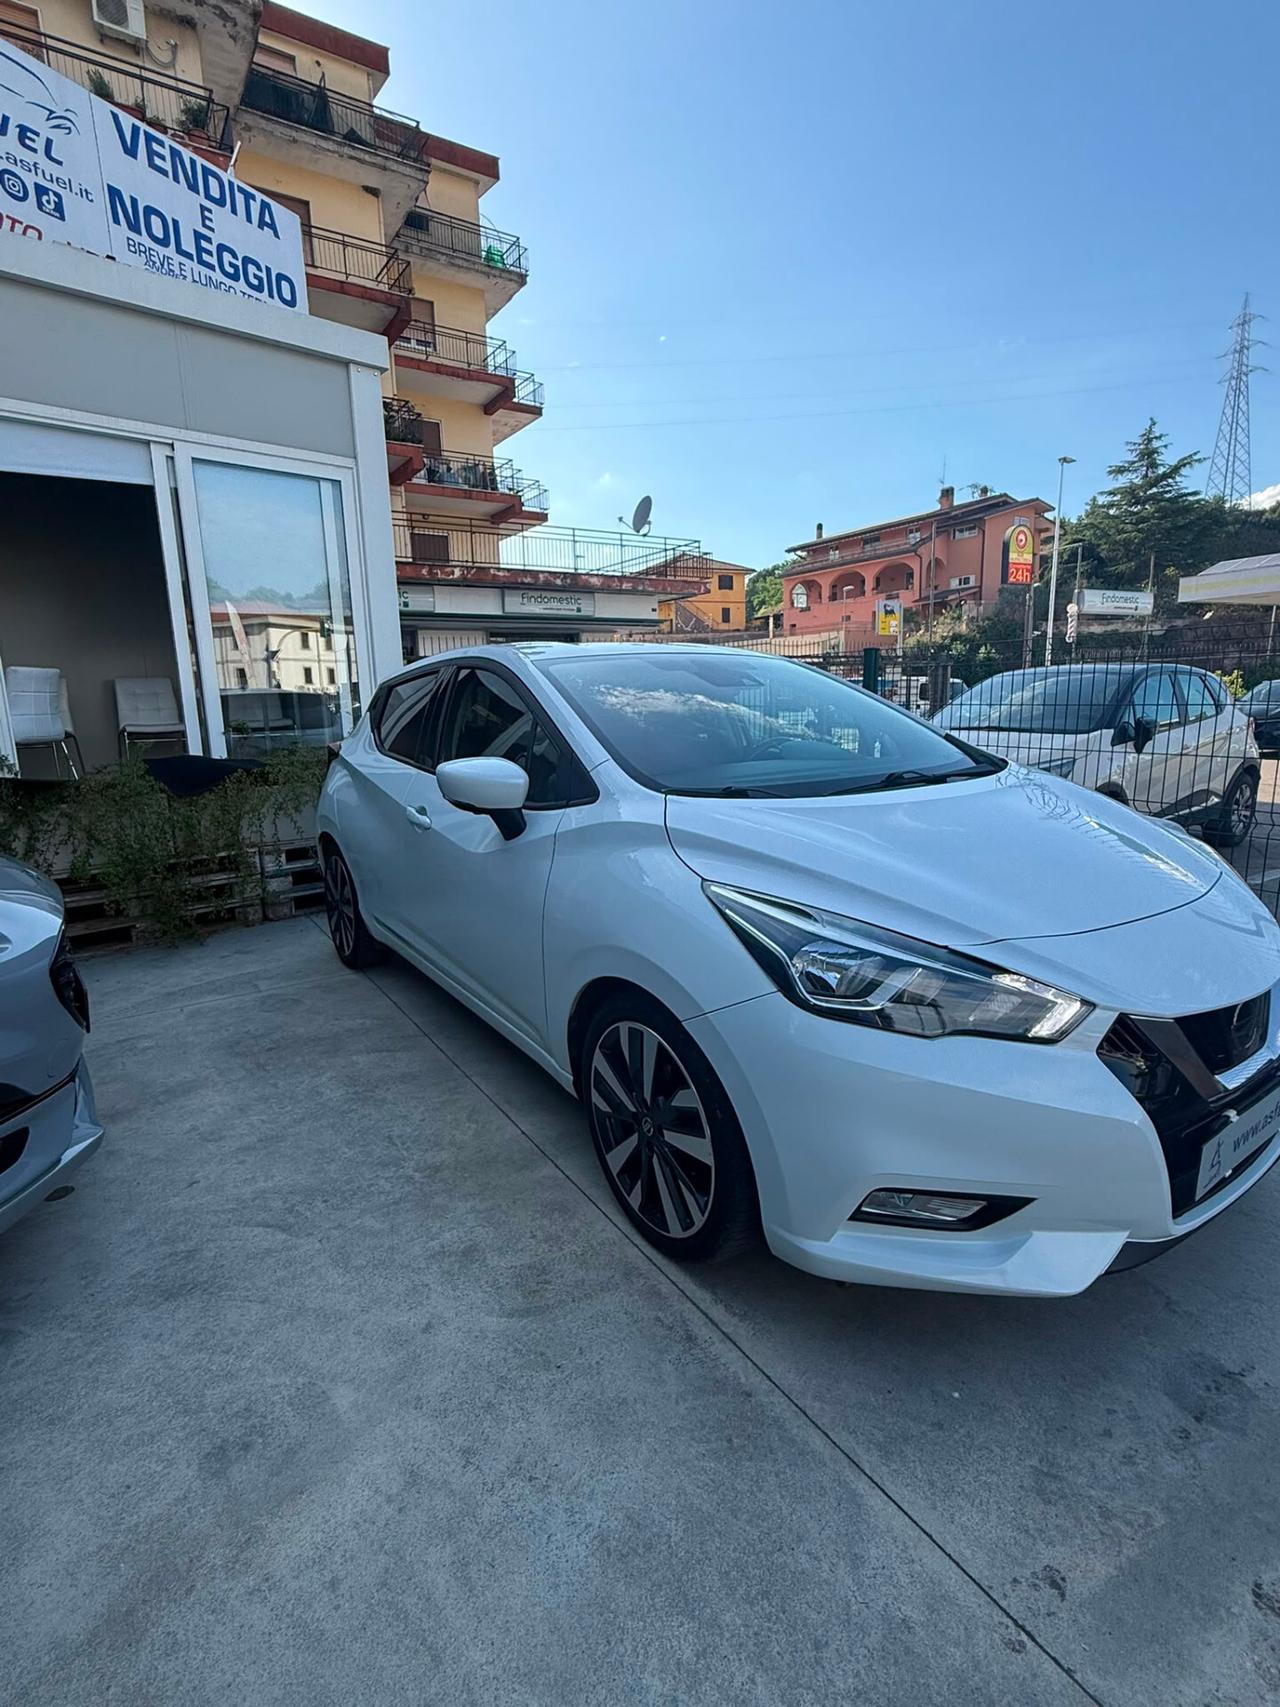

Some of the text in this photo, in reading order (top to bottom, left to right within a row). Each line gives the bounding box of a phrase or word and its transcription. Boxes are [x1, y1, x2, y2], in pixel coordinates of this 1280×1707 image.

[110, 110, 281, 240] VENDITA
[200, 203, 215, 233] E
[107, 183, 298, 309] NOLEGGIO
[127, 236, 174, 272] BREVE
[179, 261, 188, 277] E
[1010, 568, 1031, 583] 24h
[520, 592, 582, 606] Findomestic
